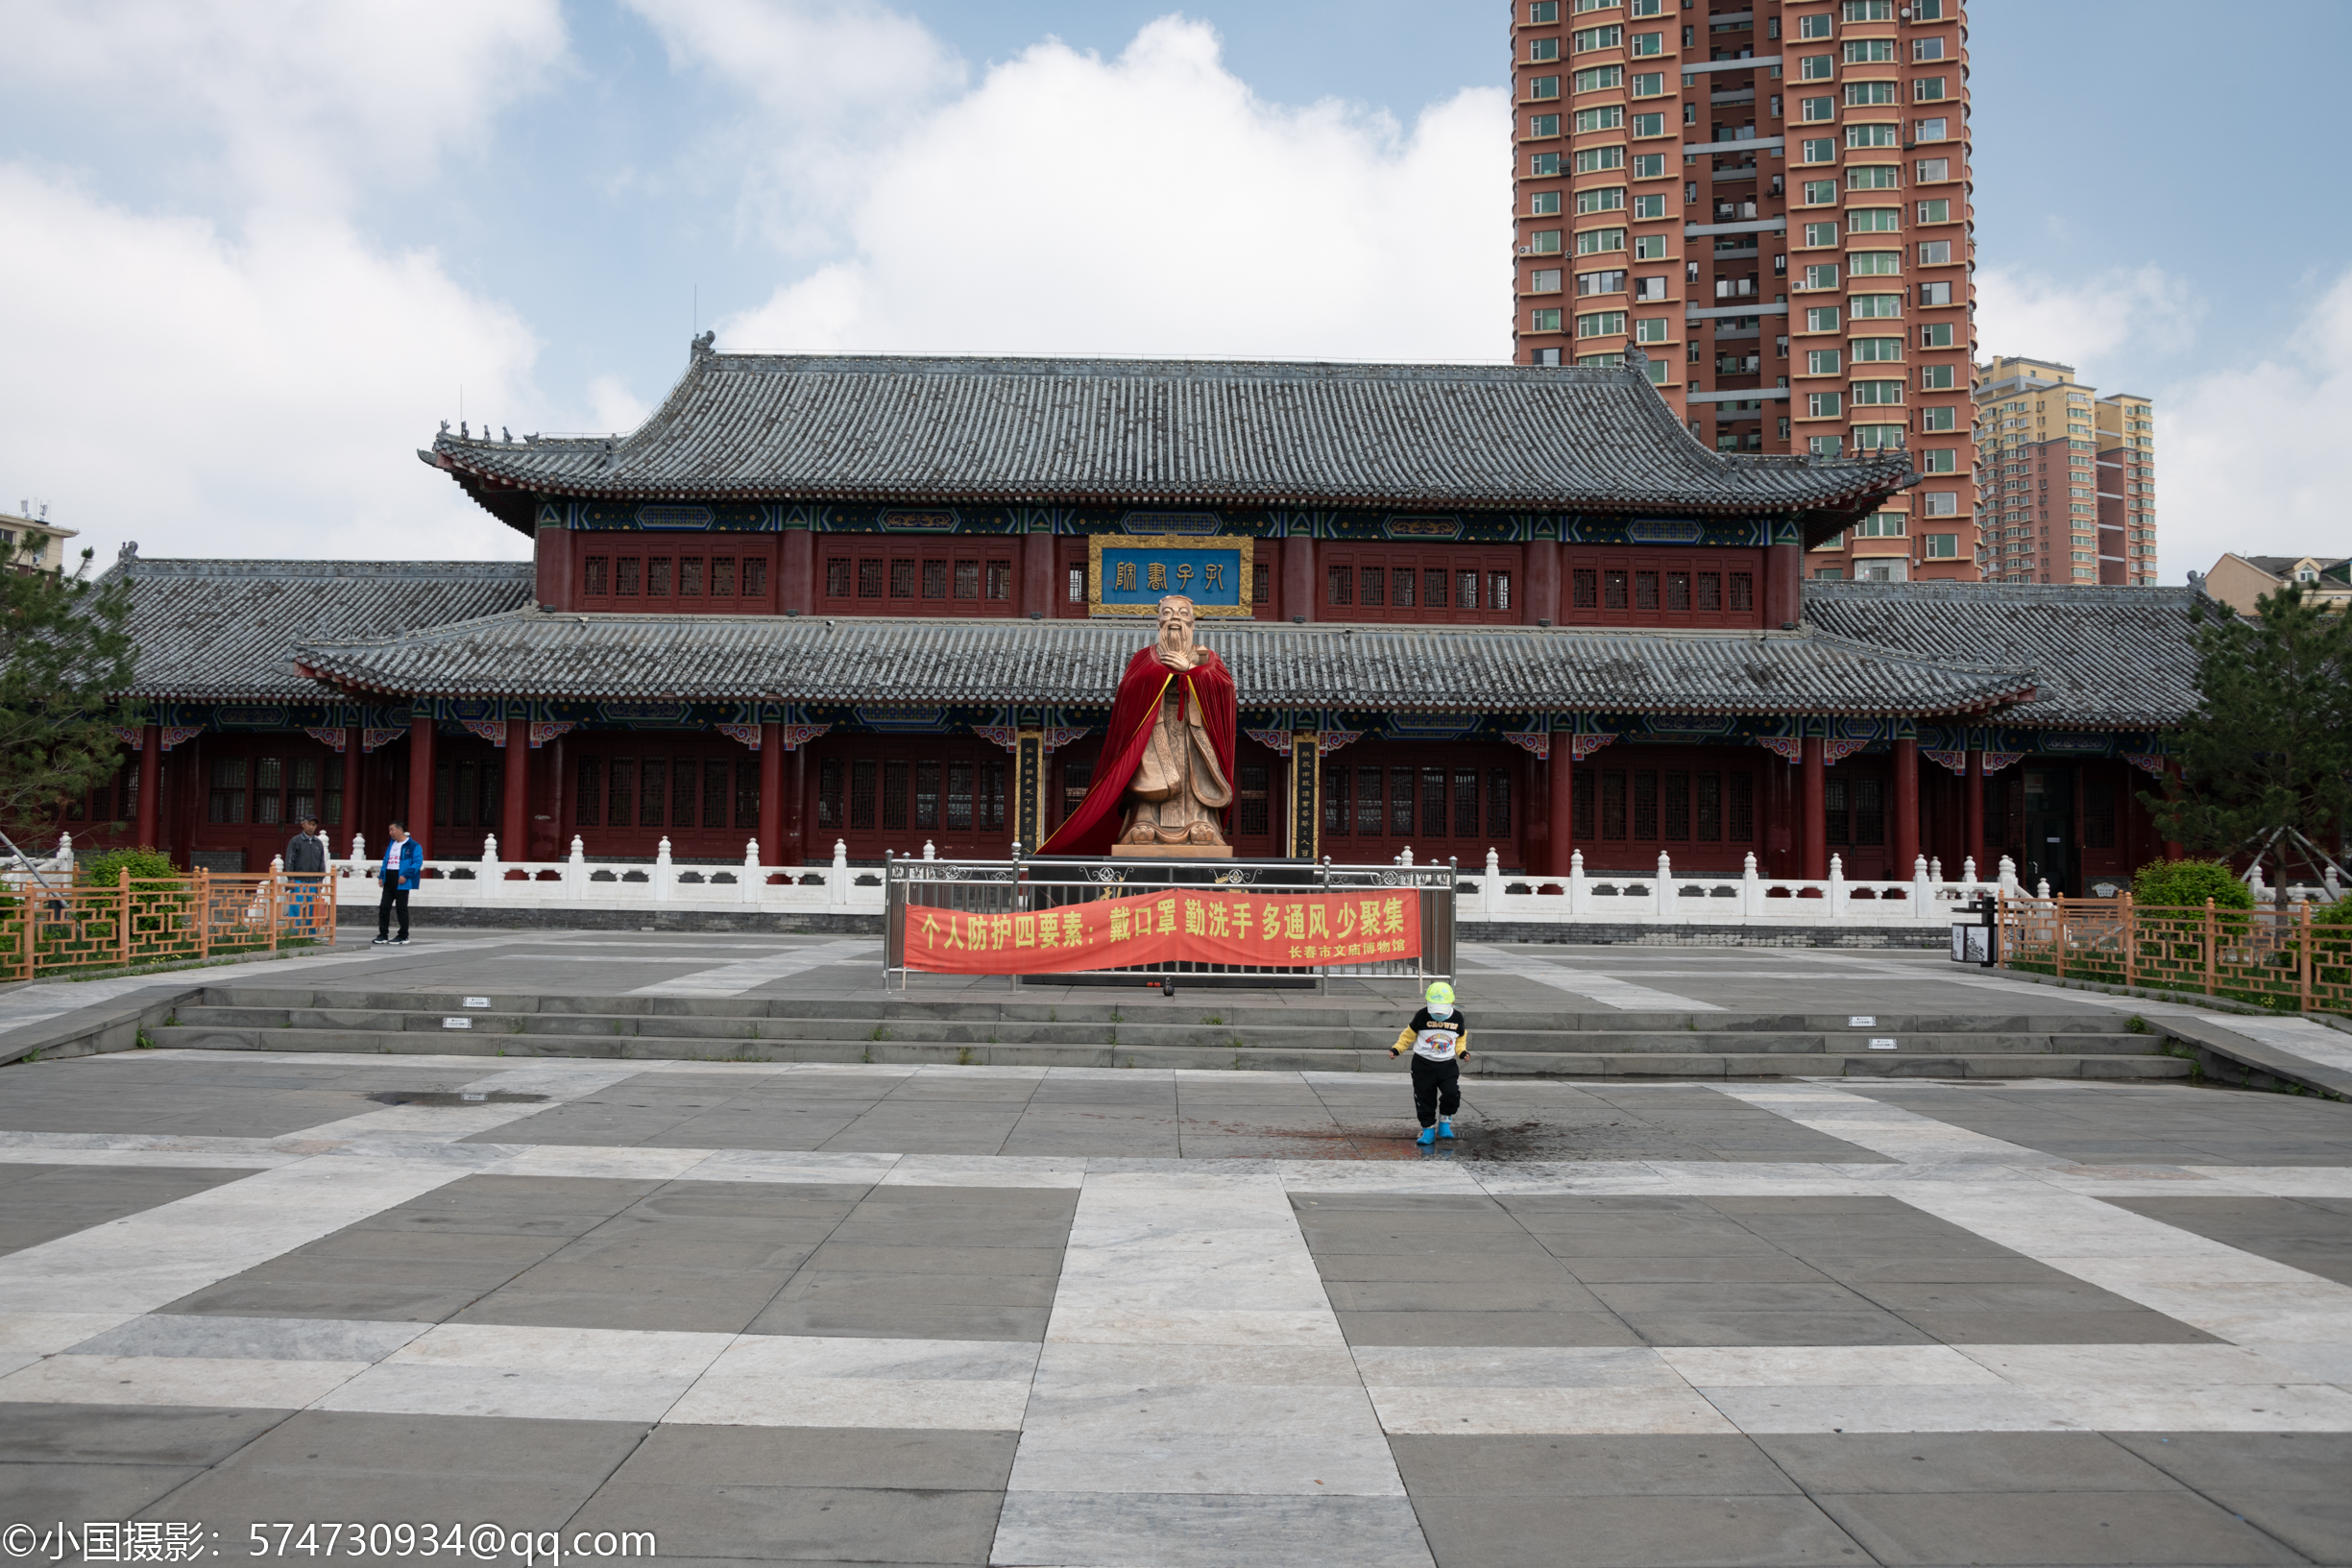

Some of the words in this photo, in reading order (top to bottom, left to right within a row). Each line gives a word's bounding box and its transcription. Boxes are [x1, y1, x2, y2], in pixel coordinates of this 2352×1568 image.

[1288, 938, 1406, 959] 长春市文庙博物馆
